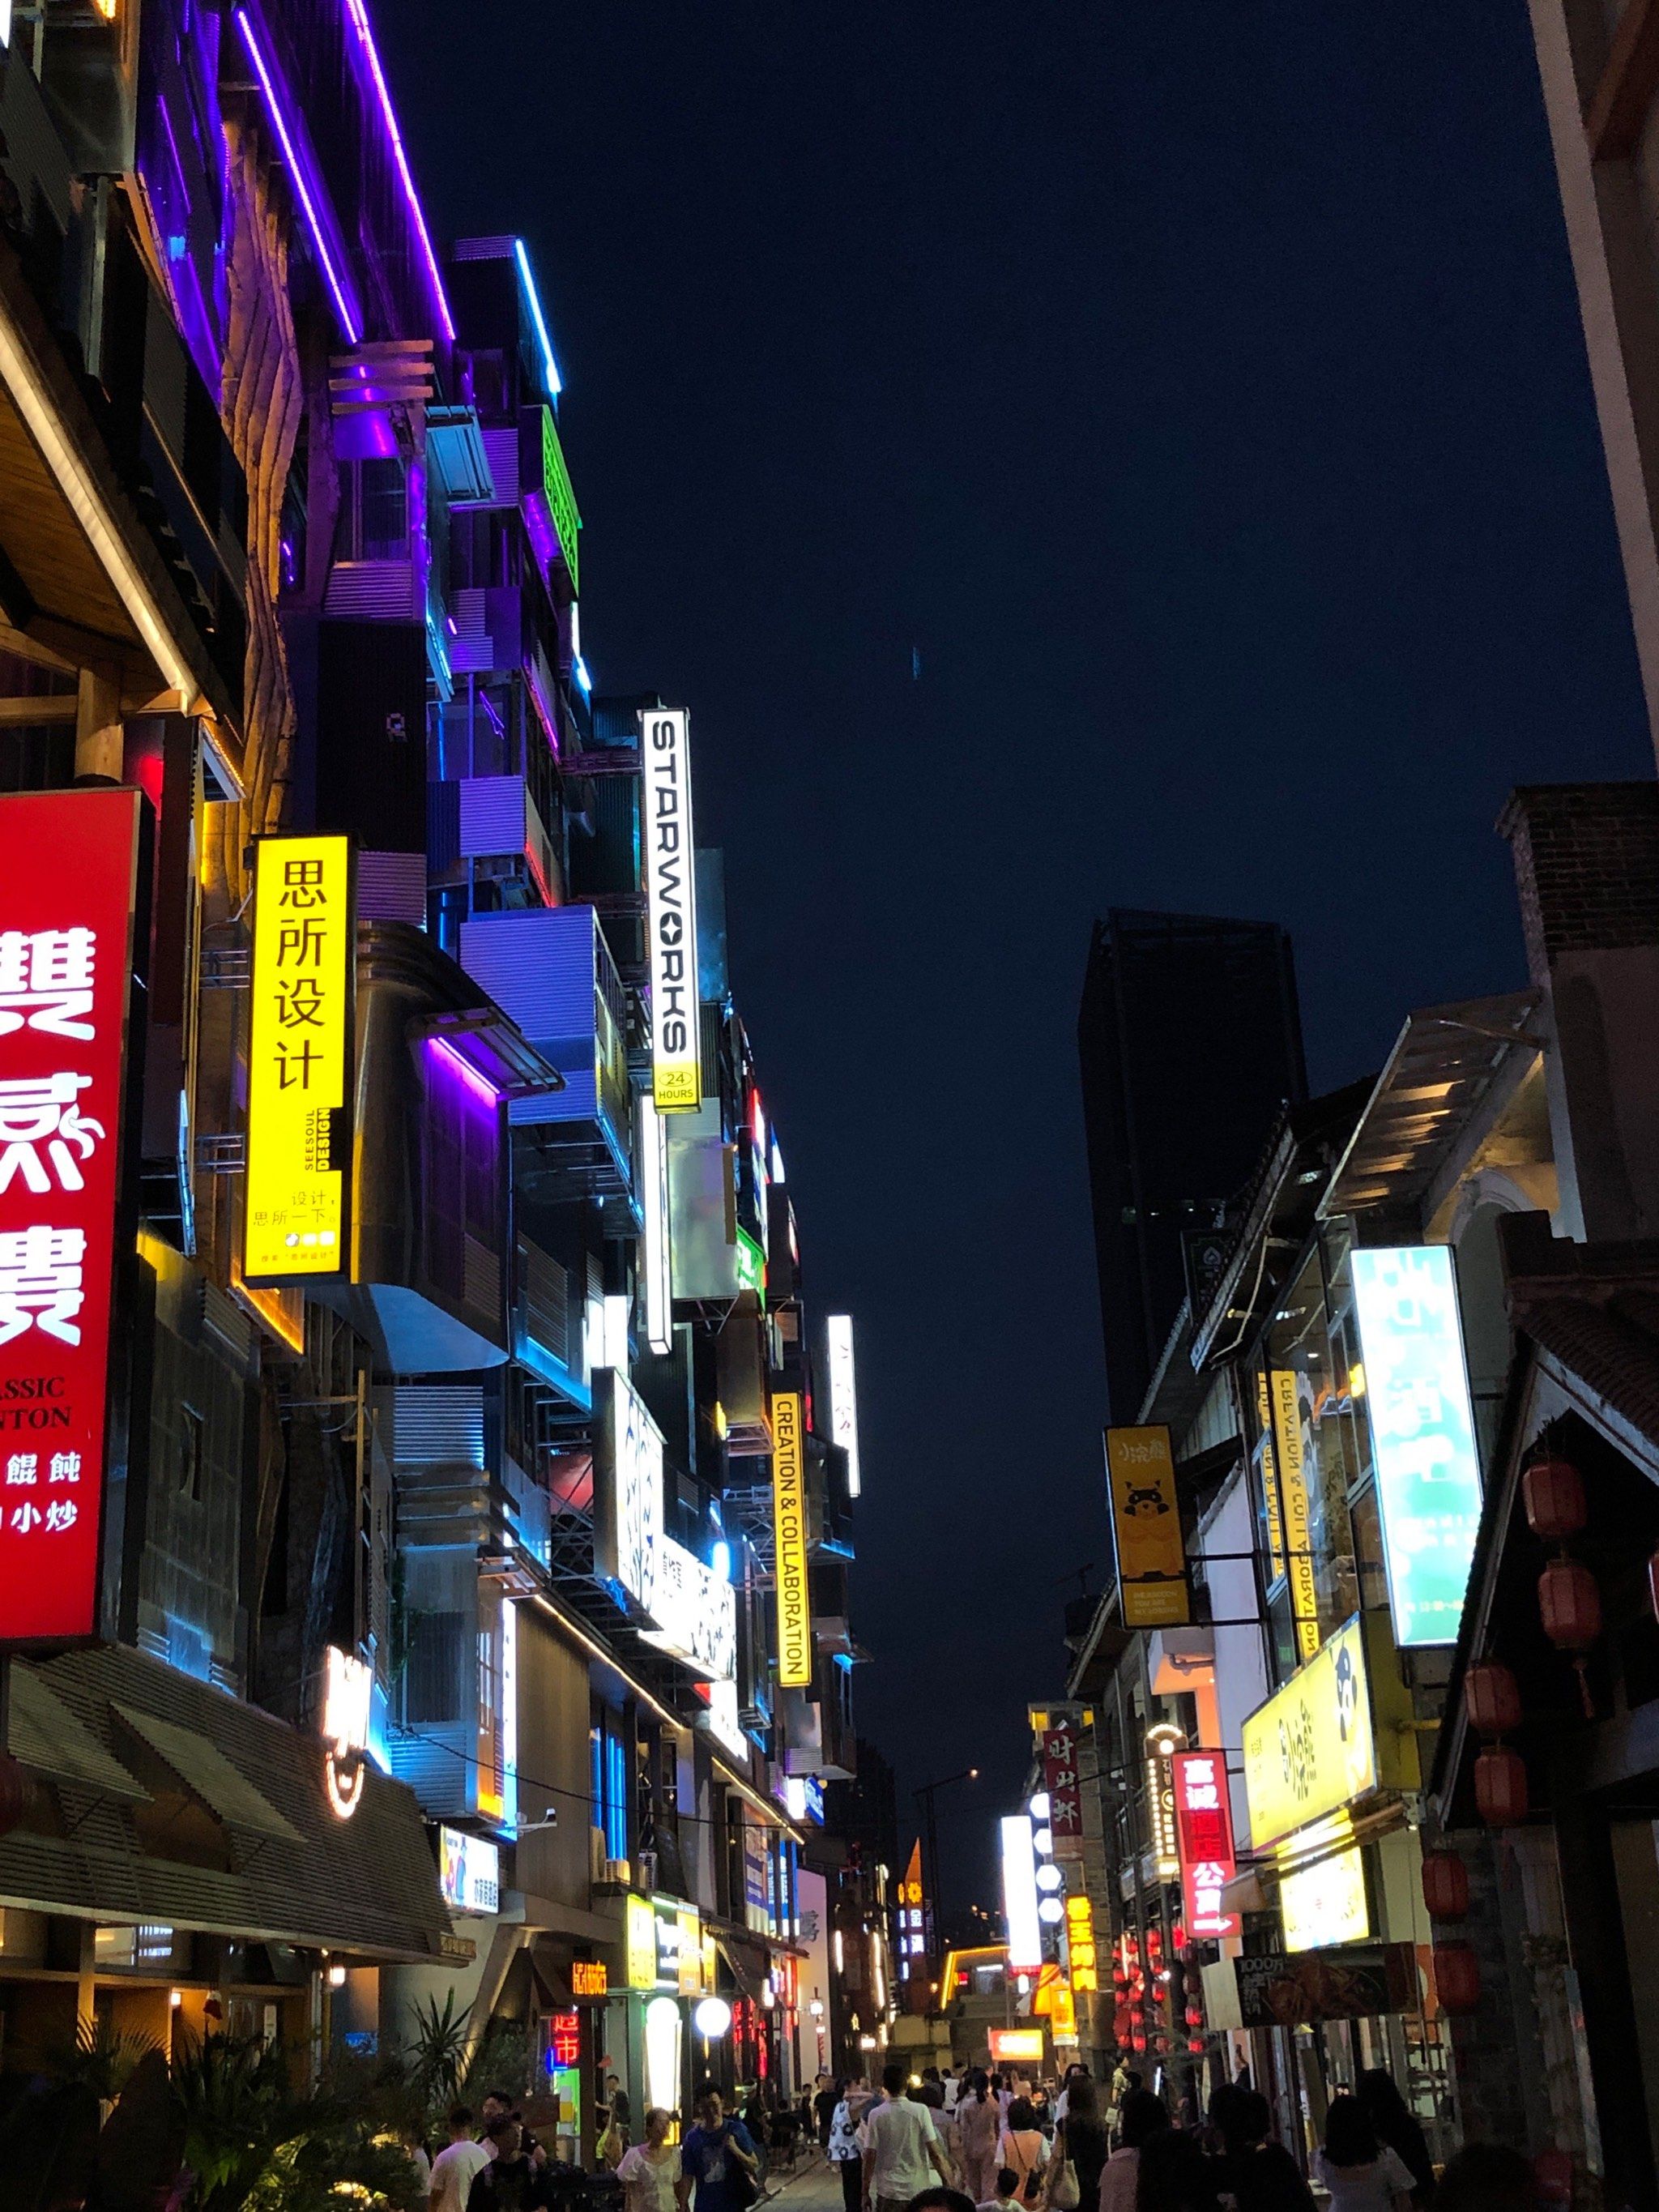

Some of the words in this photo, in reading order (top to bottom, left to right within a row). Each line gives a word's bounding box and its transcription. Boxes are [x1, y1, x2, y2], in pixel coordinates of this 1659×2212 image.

[652, 720, 687, 1054] STARWORKS
[272, 859, 328, 1091] 思所设计
[659, 1089, 694, 1100] HOURS
[667, 1072, 684, 1086] 24
[305, 1110, 315, 1171] SEESOUL
[317, 1108, 331, 1172] DESIGN
[776, 1400, 796, 1492] CREATION
[781, 1497, 795, 1510] &
[781, 1515, 804, 1676] COLLABORATION
